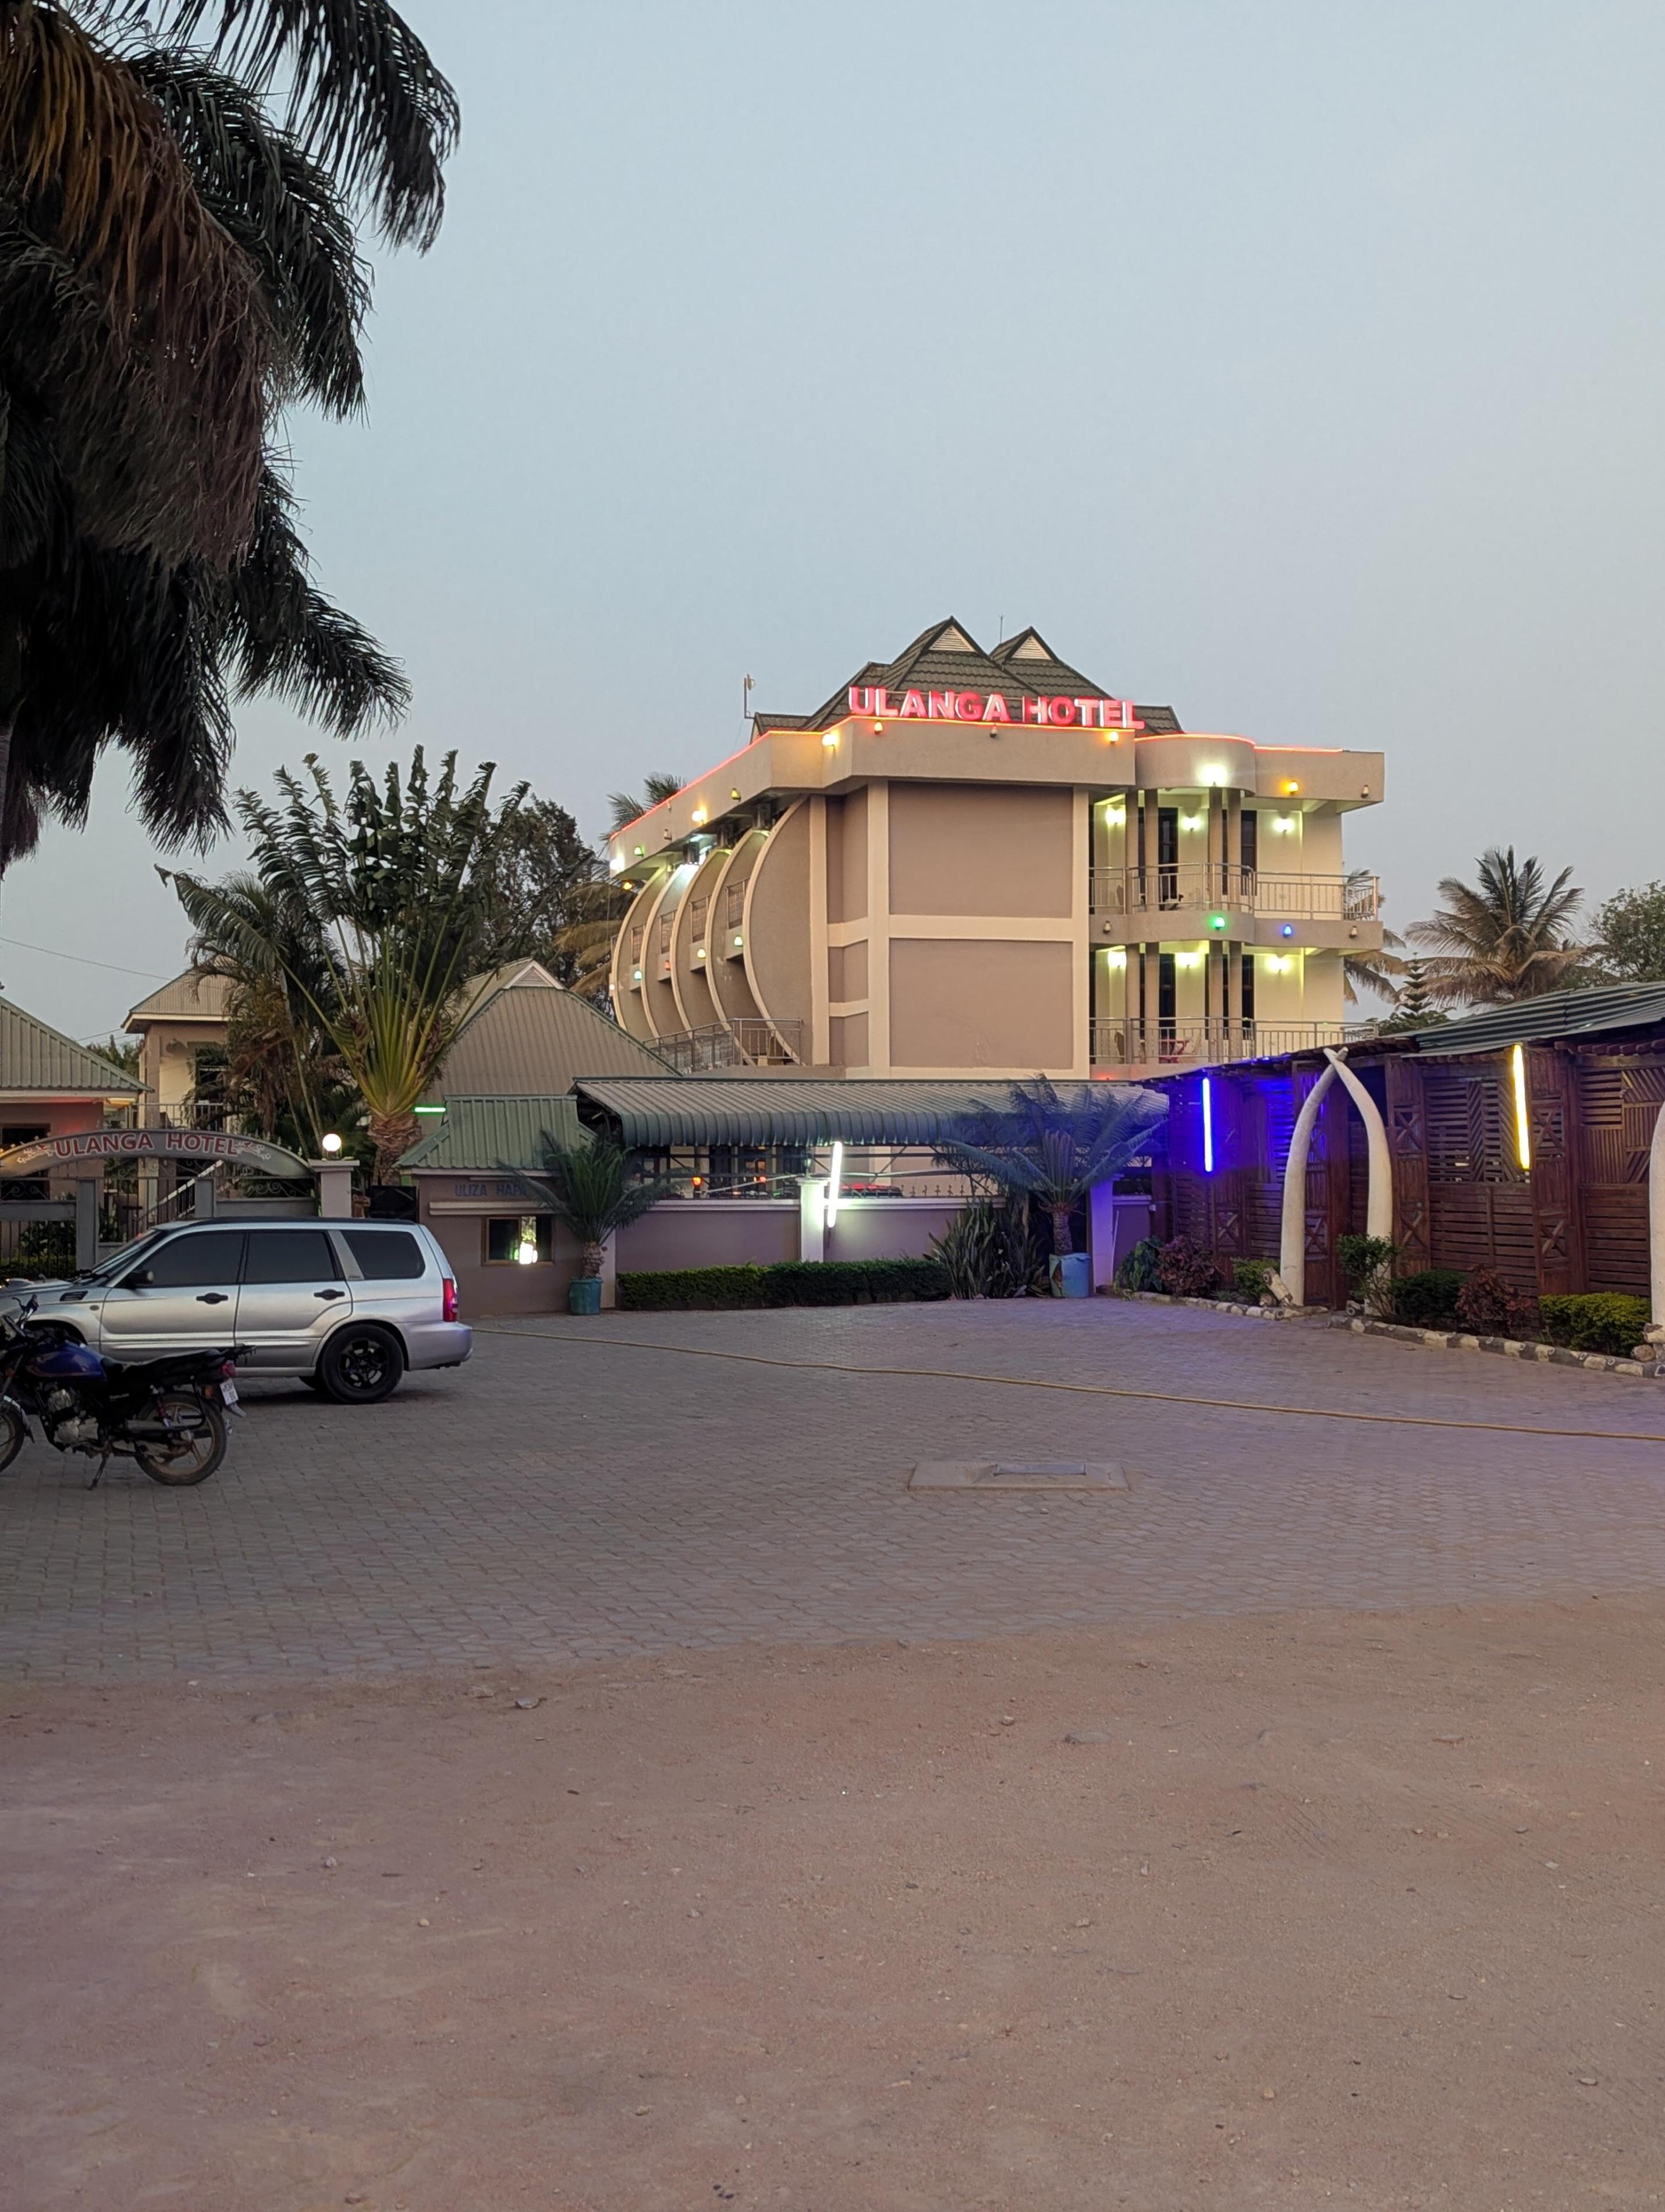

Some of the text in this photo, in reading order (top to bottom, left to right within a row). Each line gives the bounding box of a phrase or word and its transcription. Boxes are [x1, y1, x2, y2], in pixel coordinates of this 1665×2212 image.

[848, 686, 1145, 729] ULANGA HOTEL
[55, 1133, 239, 1157] ULANGA HOTEL
[455, 1184, 488, 1197] ULIZA
